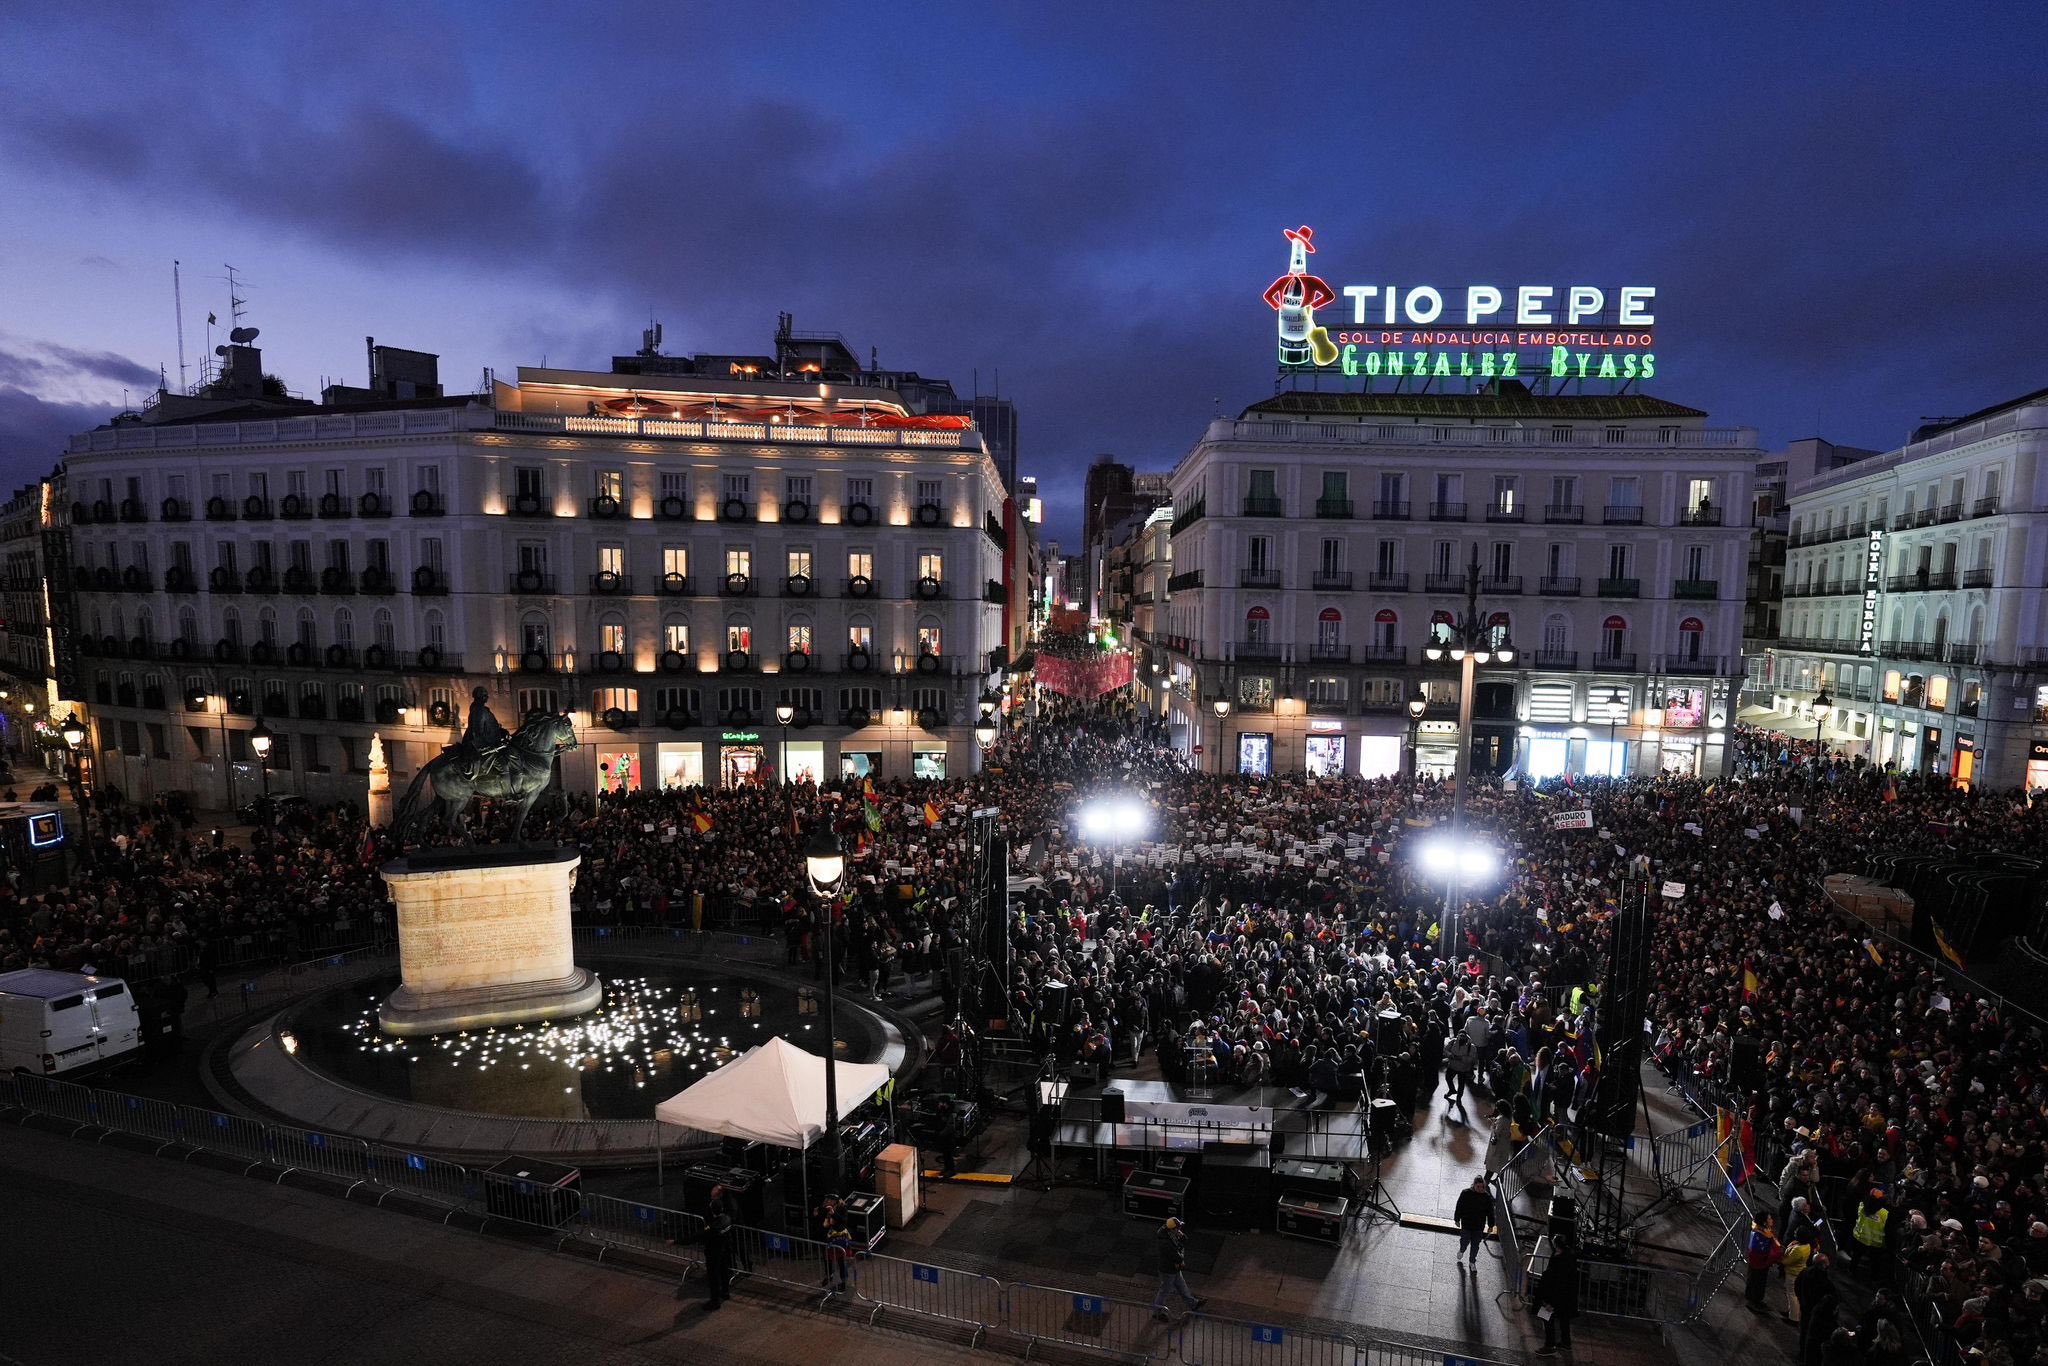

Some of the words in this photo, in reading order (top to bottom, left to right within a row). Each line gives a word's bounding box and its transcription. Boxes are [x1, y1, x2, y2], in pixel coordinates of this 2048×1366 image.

[1343, 286, 1443, 324] TIO
[1467, 286, 1656, 325] PEPE
[1339, 332, 1375, 345] SOL
[1381, 332, 1403, 345] DE
[1411, 333, 1511, 345] ANDALUCIA
[1518, 333, 1652, 346] EMBOTELLADO
[1868, 530, 1882, 582] HOTEL
[1860, 590, 1876, 652] EUROPA
[1663, 736, 1702, 744] SEPHORA
[1554, 811, 1586, 822] MADURO
[1555, 819, 1587, 829] ASESINO
